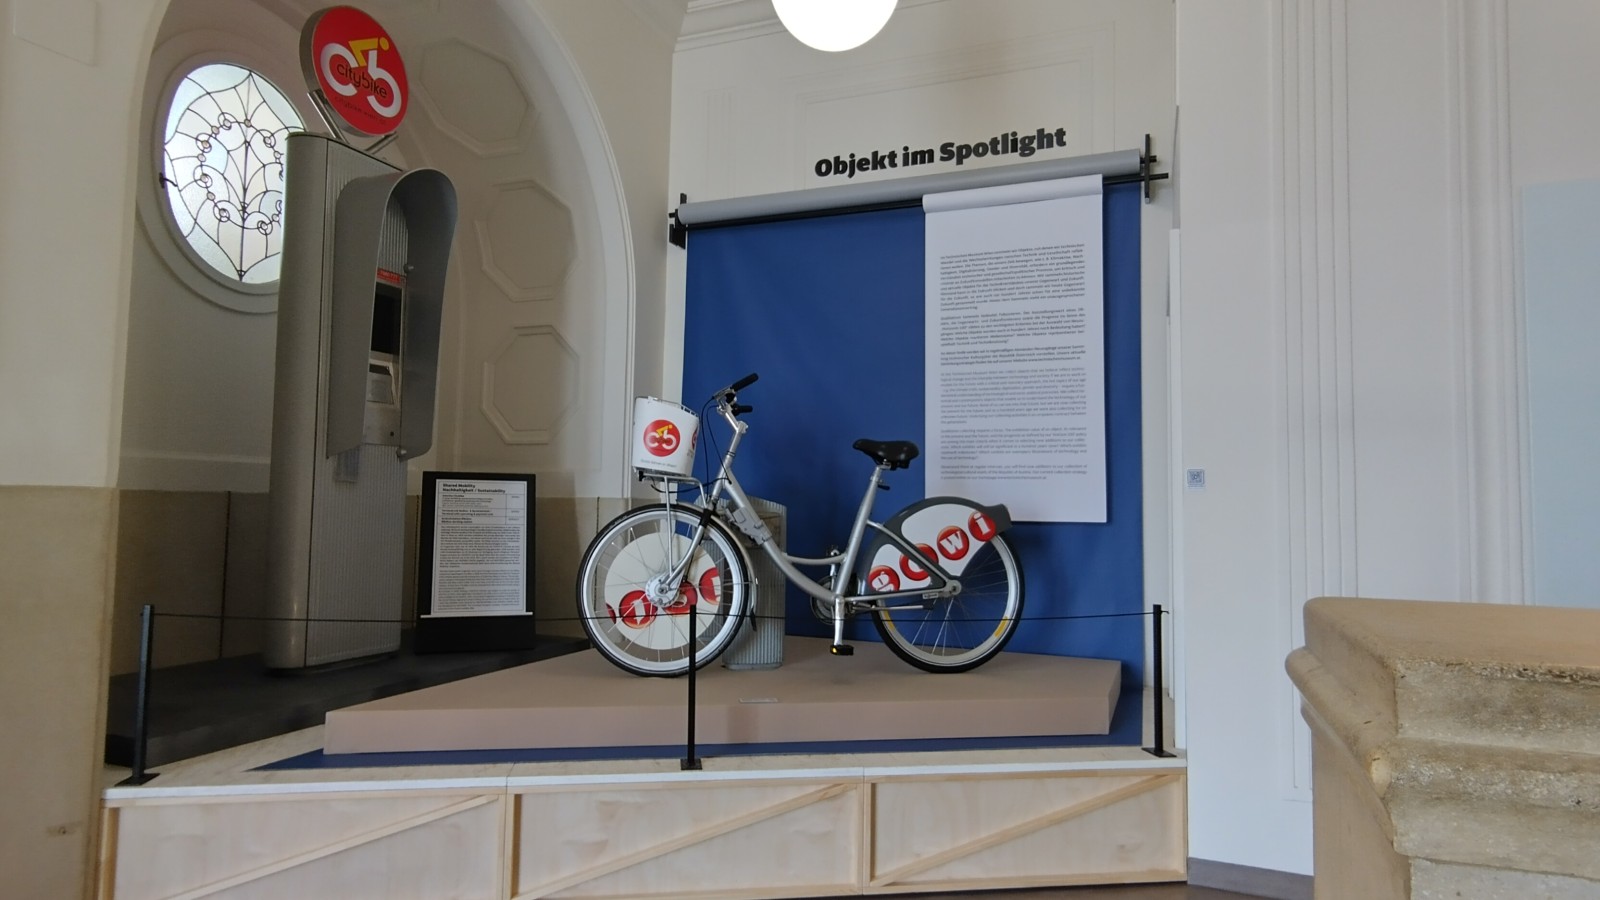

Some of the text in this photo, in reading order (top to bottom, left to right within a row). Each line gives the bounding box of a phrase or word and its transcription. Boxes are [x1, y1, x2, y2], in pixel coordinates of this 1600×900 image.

[336, 63, 388, 98] citybike
[814, 127, 1067, 179] Objekt im Spotlight
